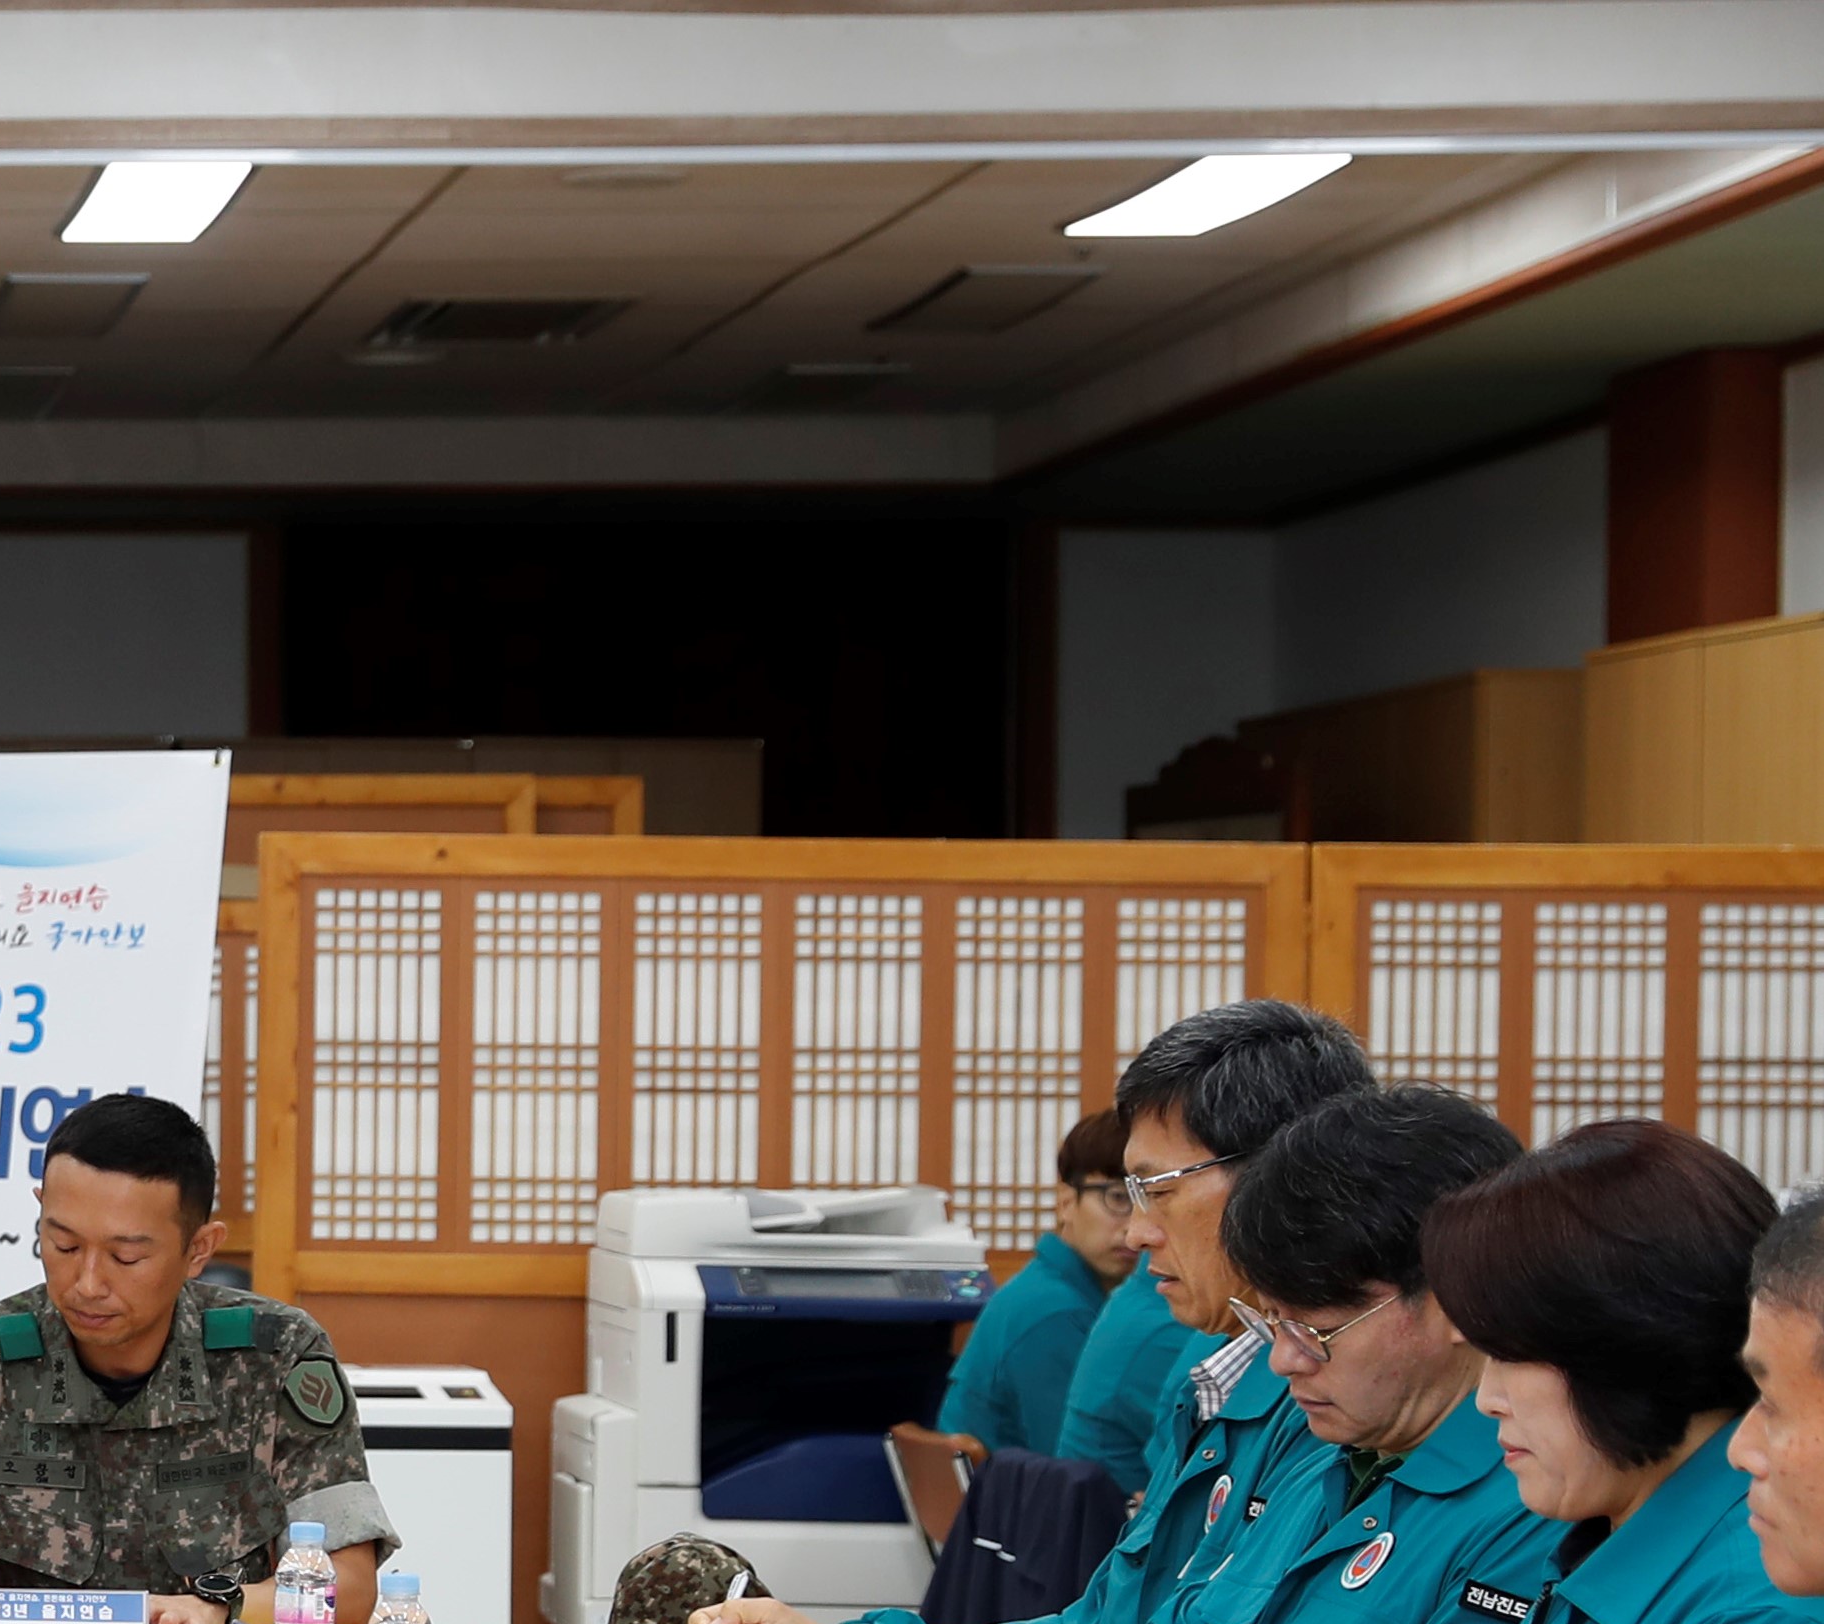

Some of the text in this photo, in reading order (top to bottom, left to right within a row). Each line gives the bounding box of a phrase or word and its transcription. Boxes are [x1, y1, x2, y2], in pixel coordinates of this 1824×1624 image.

[16, 883, 110, 915] 을지연습
[47, 921, 147, 951] 국가안보
[41, 1603, 113, 1621] 을지연습
[1466, 1586, 1529, 1618] 전남진도
